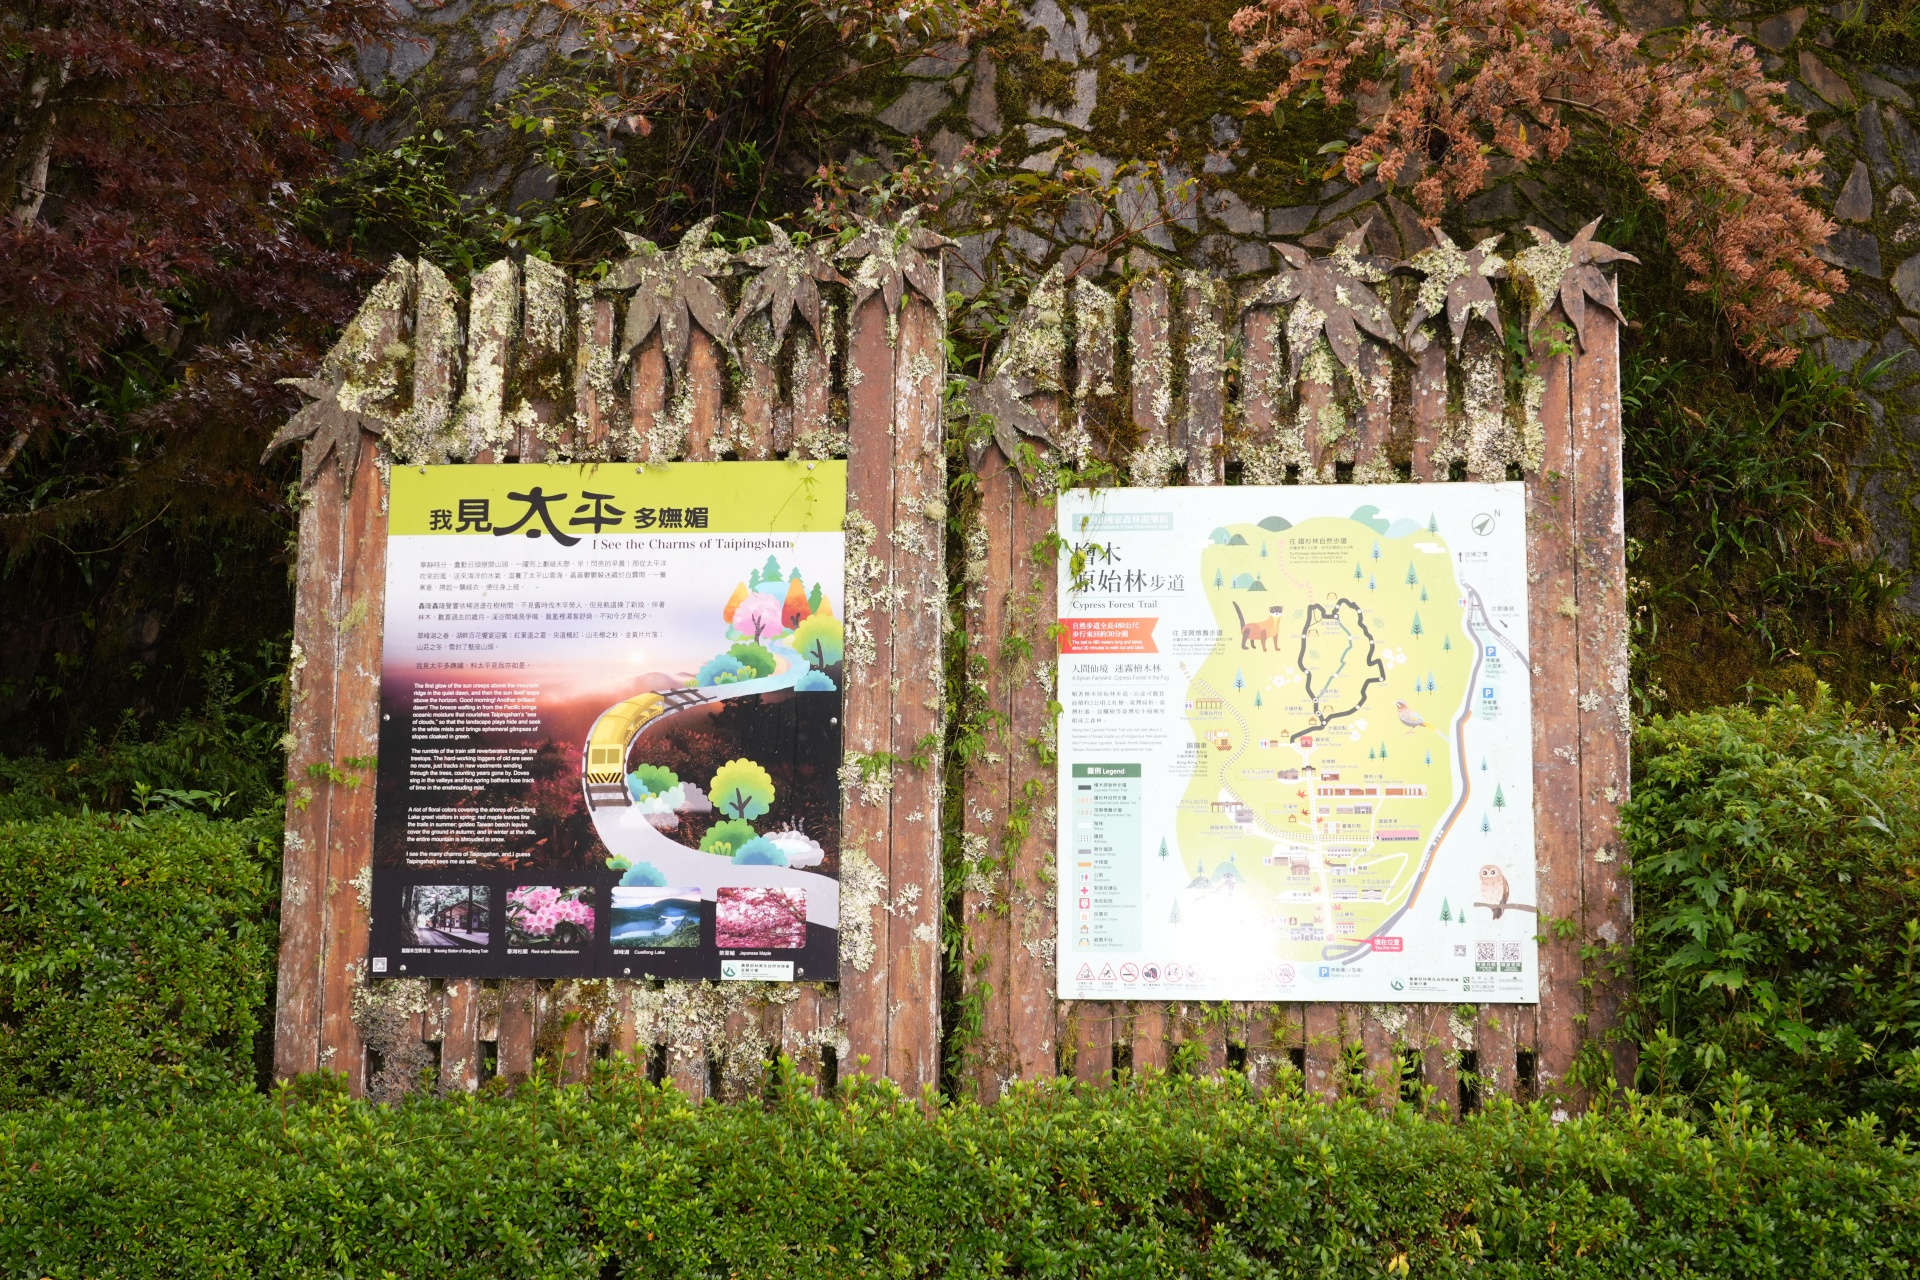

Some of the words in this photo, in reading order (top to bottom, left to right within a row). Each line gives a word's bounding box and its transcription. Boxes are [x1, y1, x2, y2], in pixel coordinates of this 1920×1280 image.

[430, 486, 709, 546] 我見太平多嫵媚
[601, 540, 621, 549] See
[626, 540, 644, 549] the
[649, 540, 695, 548] Charms
[716, 539, 790, 549] Taipingshan
[1072, 601, 1106, 610] Cypress
